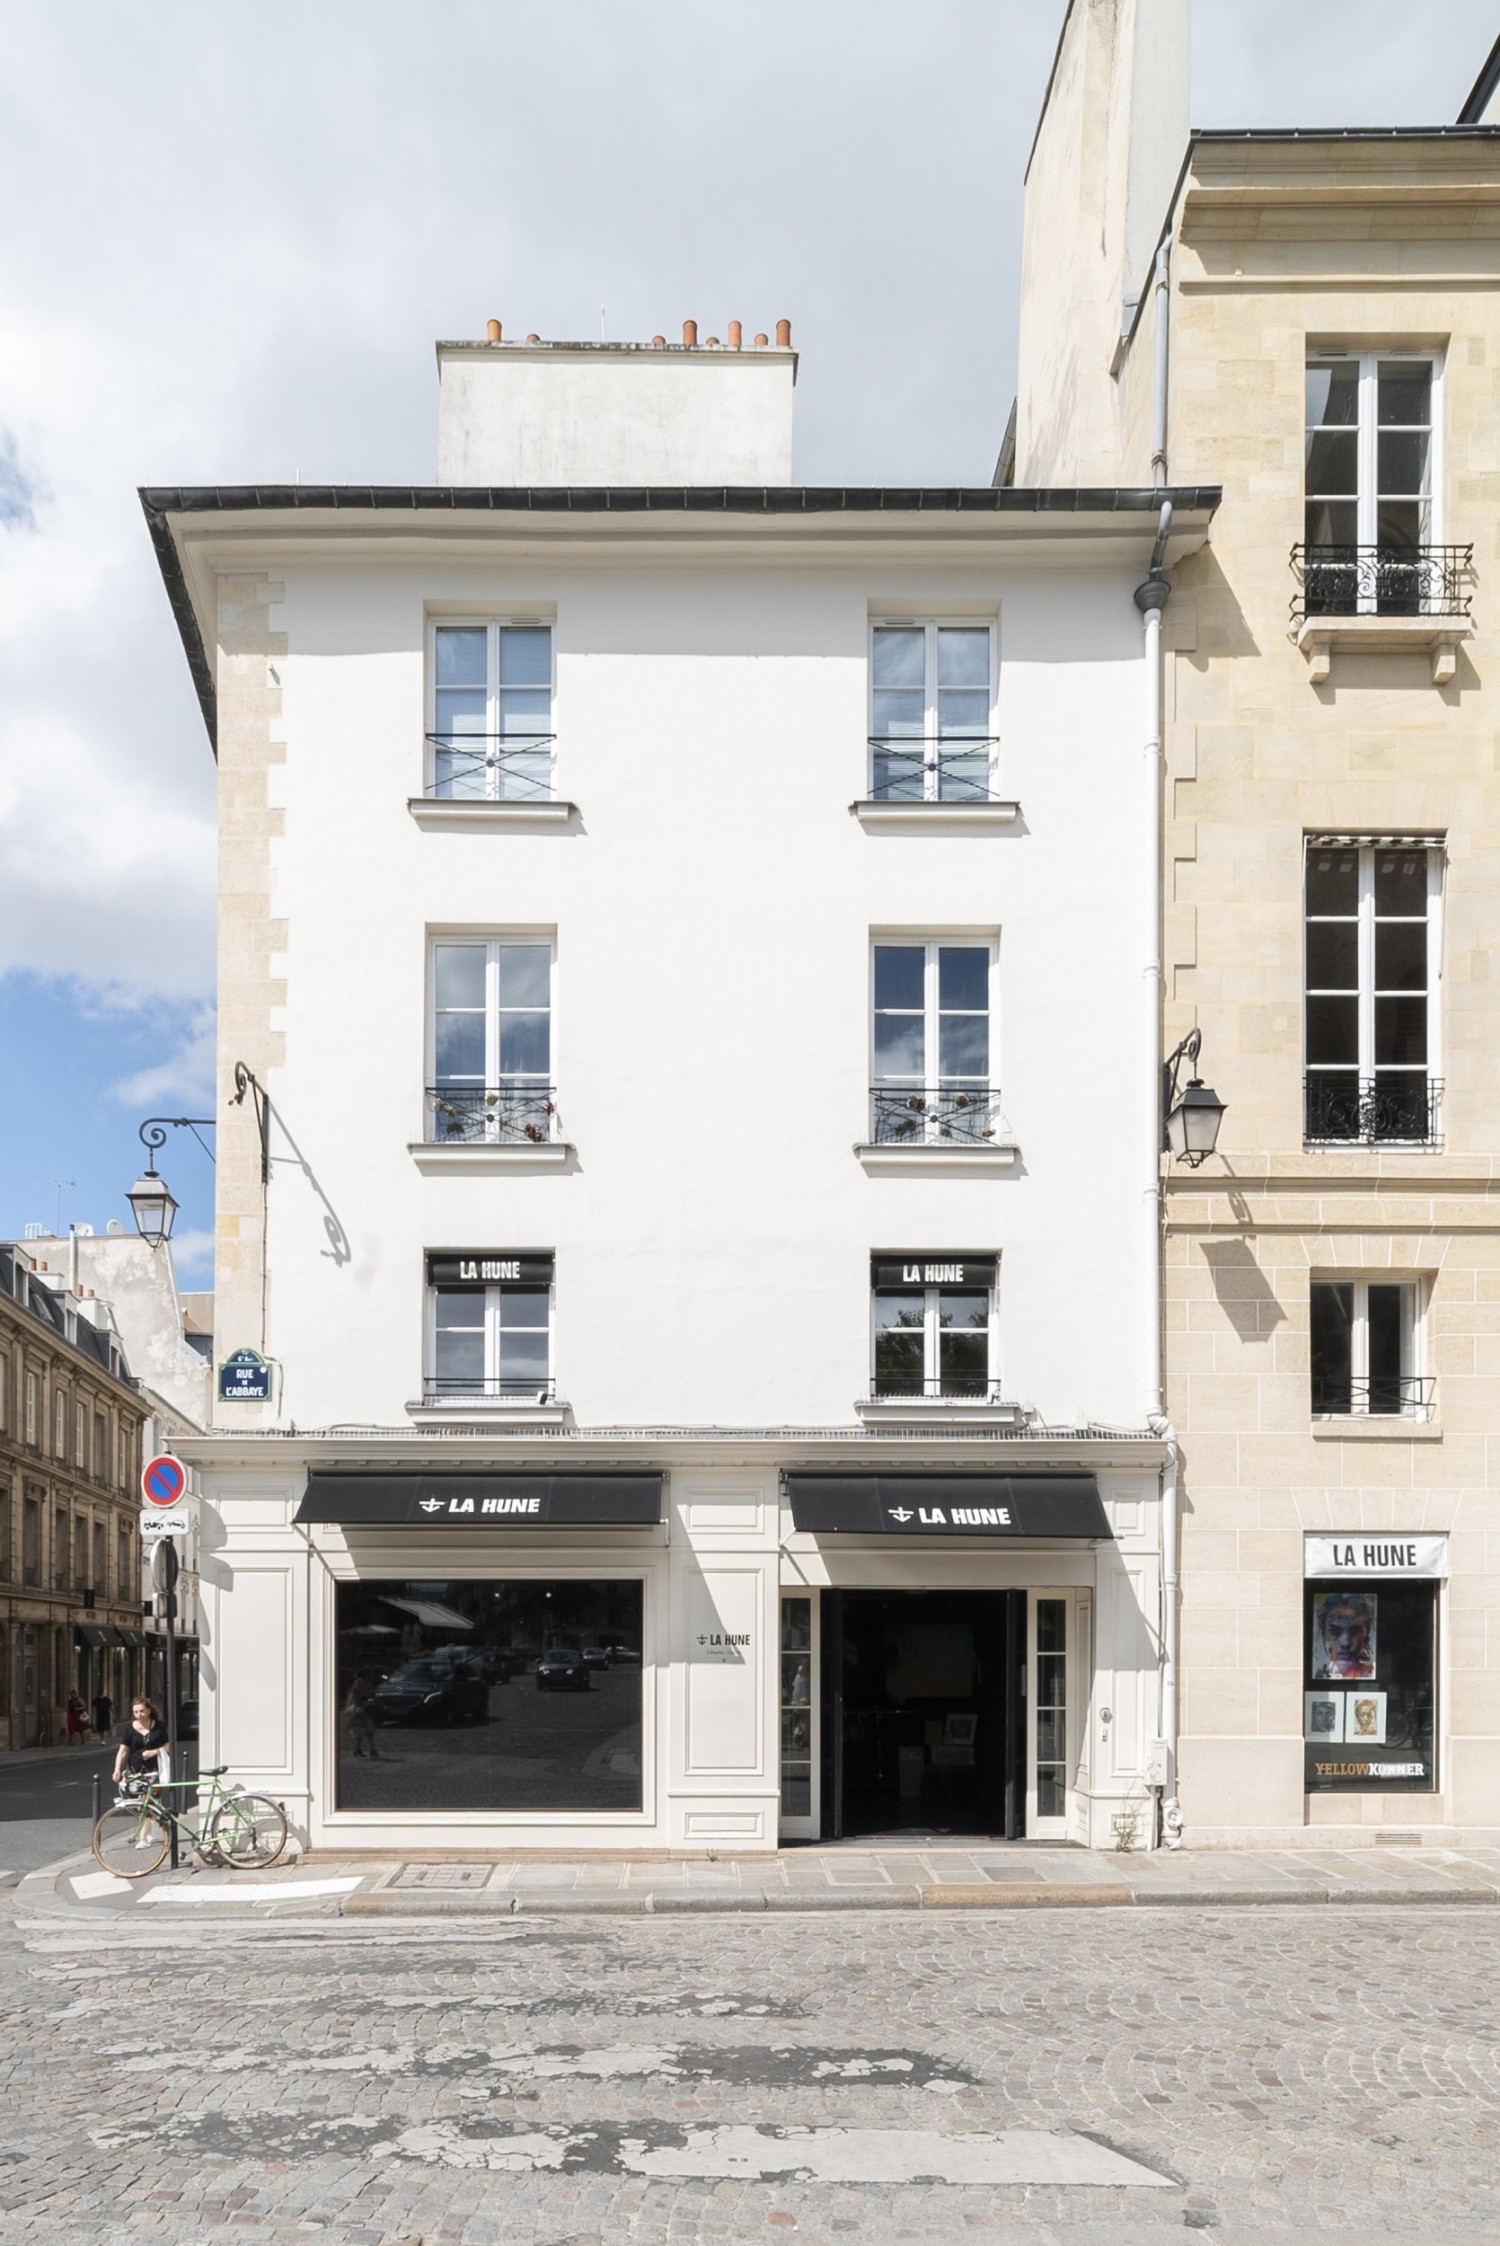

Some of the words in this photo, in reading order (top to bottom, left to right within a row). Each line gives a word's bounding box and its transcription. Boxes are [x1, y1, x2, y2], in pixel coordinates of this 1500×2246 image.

[460, 1261, 478, 1279] LA
[481, 1261, 521, 1279] HUNE
[903, 1265, 921, 1282] LA
[925, 1264, 964, 1282] HUNE
[236, 1369, 254, 1379] RUE
[225, 1386, 264, 1397] L'ABBAYE
[448, 1498, 475, 1513] LA
[481, 1498, 541, 1513] HUNE
[918, 1507, 947, 1524] LA
[950, 1507, 1012, 1525] HUNE
[1333, 1544, 1356, 1567] LA
[1363, 1544, 1417, 1567] HUNE
[710, 1634, 722, 1646] LA
[724, 1634, 751, 1646] HUNE
